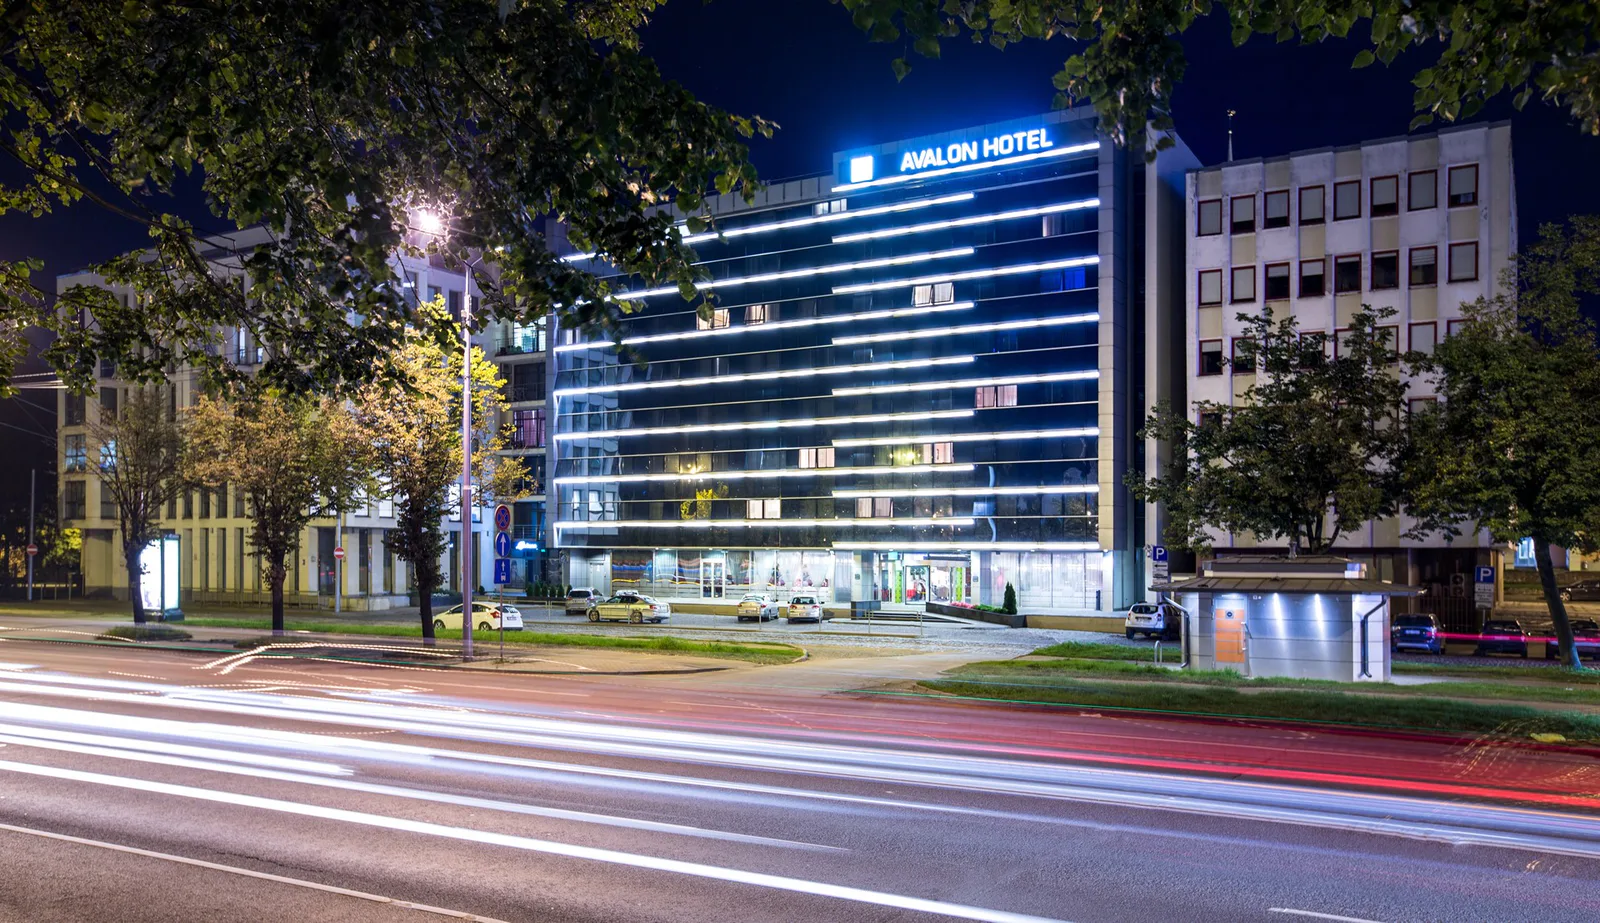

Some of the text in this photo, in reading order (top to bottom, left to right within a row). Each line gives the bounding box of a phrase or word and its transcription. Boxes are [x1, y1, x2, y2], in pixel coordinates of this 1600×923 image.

[900, 128, 1054, 172] AVALON HOTEL
[1156, 547, 1165, 560] P
[1480, 567, 1492, 582] P
